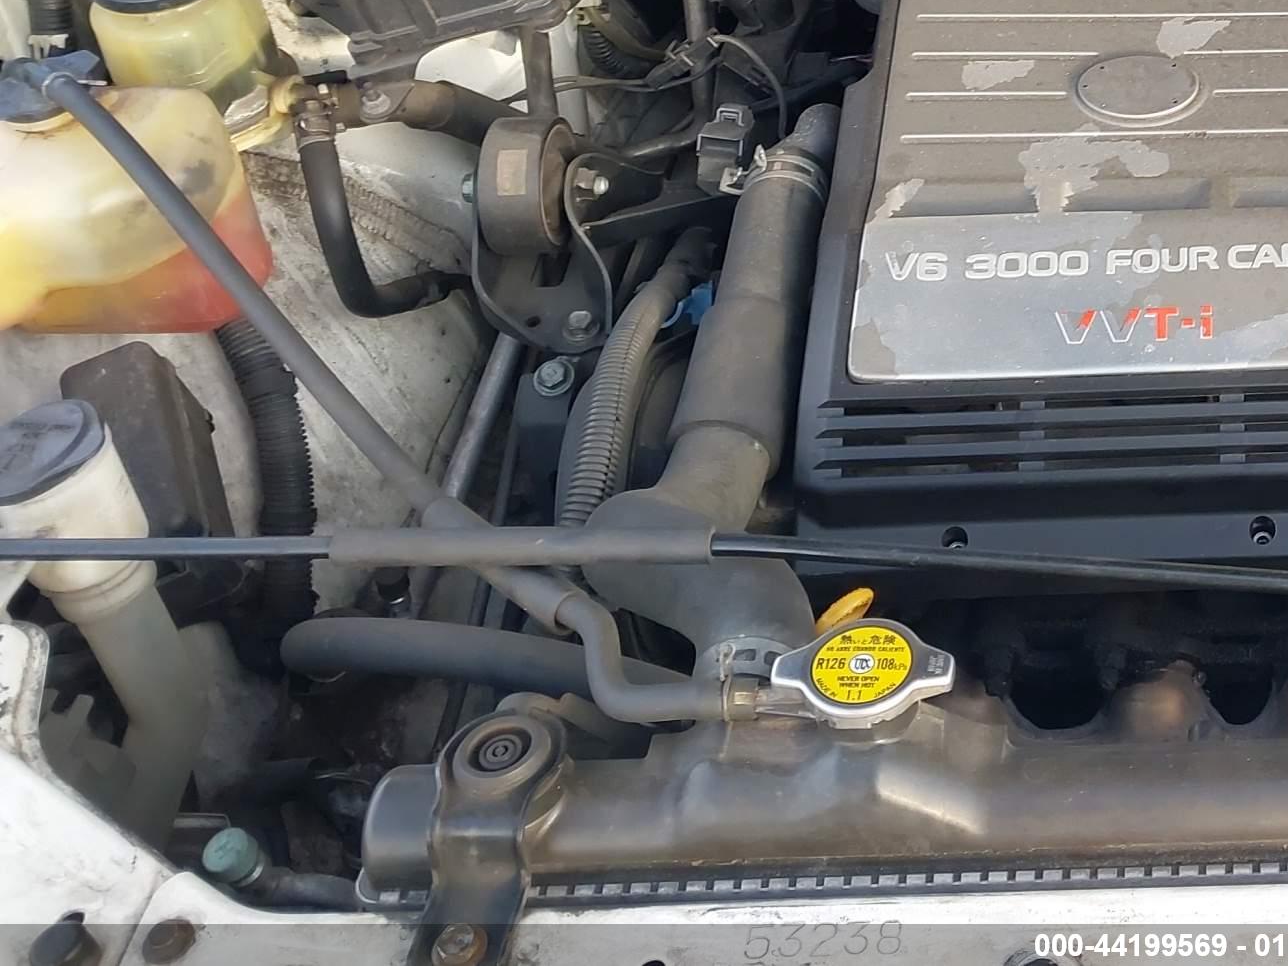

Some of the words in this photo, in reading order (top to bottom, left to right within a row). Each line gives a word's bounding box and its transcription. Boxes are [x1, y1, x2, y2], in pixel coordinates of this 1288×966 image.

[885, 251, 949, 281] V6
[965, 250, 1089, 279] 3000
[1105, 244, 1219, 275] FOUR
[1055, 305, 1214, 344] VVT-i
[816, 658, 846, 670] R126
[847, 689, 862, 701] 1.1
[874, 682, 897, 698] JAPAN
[744, 920, 902, 959] 53238
